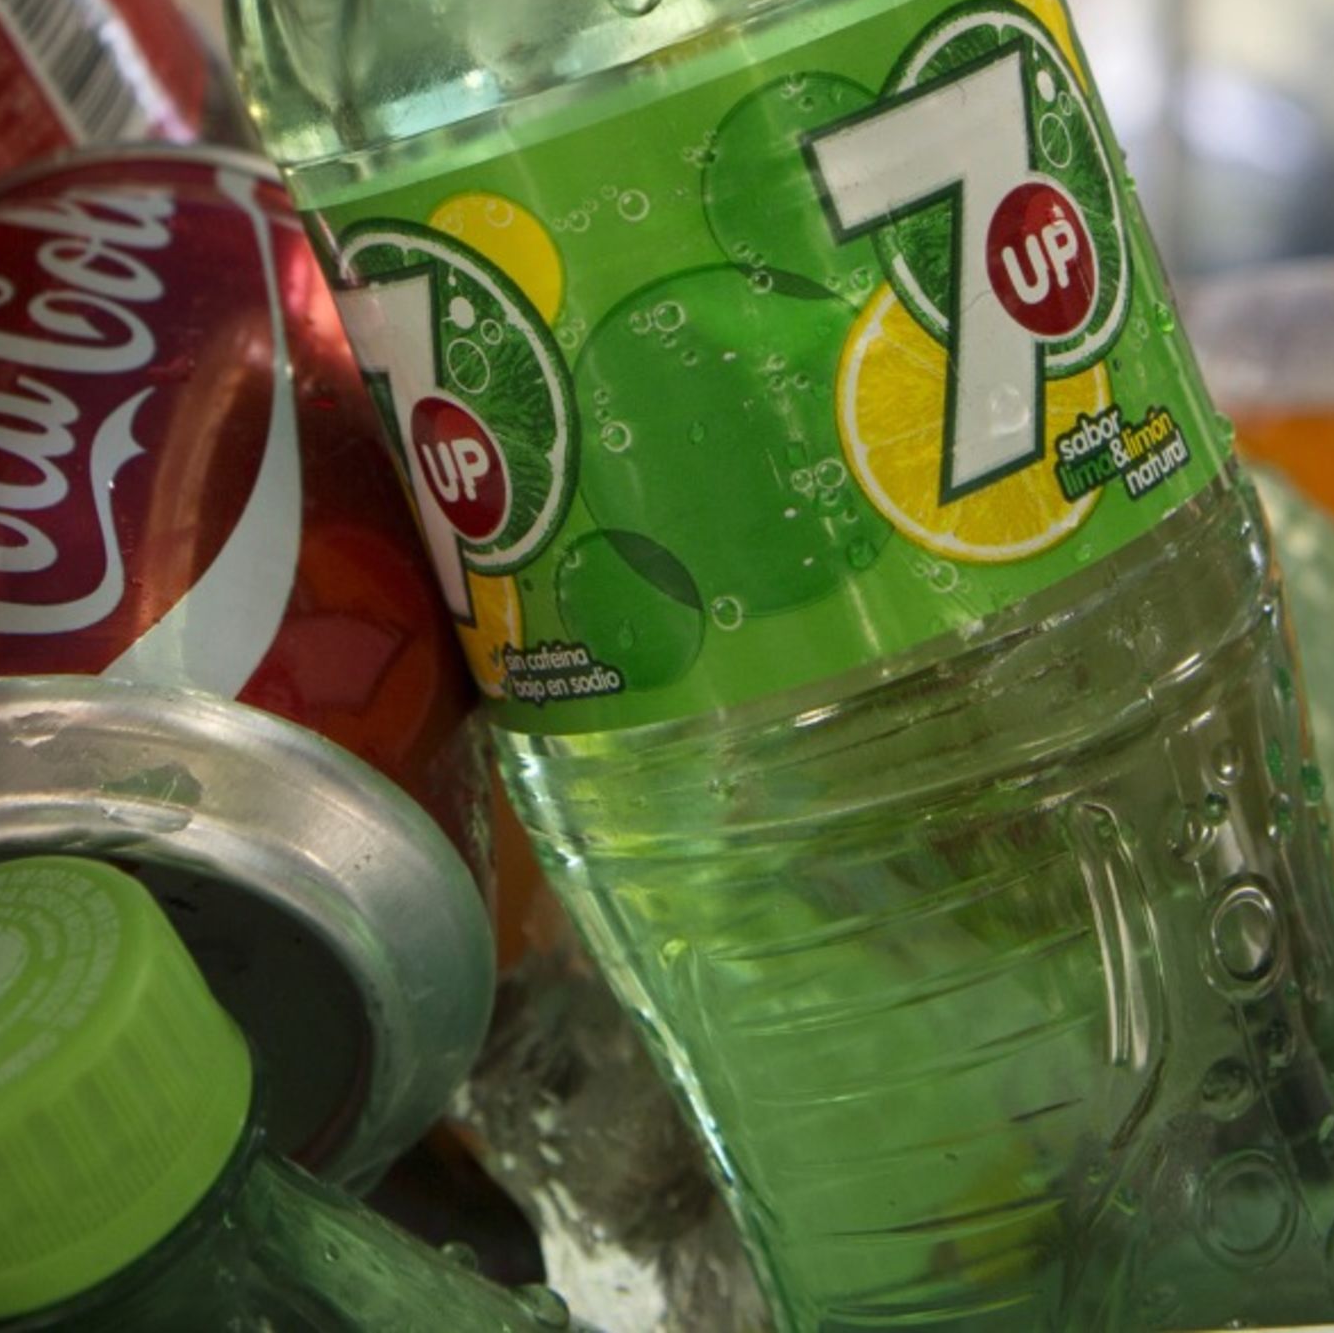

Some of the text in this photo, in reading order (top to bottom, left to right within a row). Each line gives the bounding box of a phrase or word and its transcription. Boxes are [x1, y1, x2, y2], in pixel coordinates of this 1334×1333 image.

[1002, 219, 1078, 305] UP
[1059, 410, 1121, 462] sabor
[1126, 429, 1188, 495] natural
[422, 437, 490, 504] UP
[546, 677, 569, 696] en
[569, 667, 620, 694] sodio
